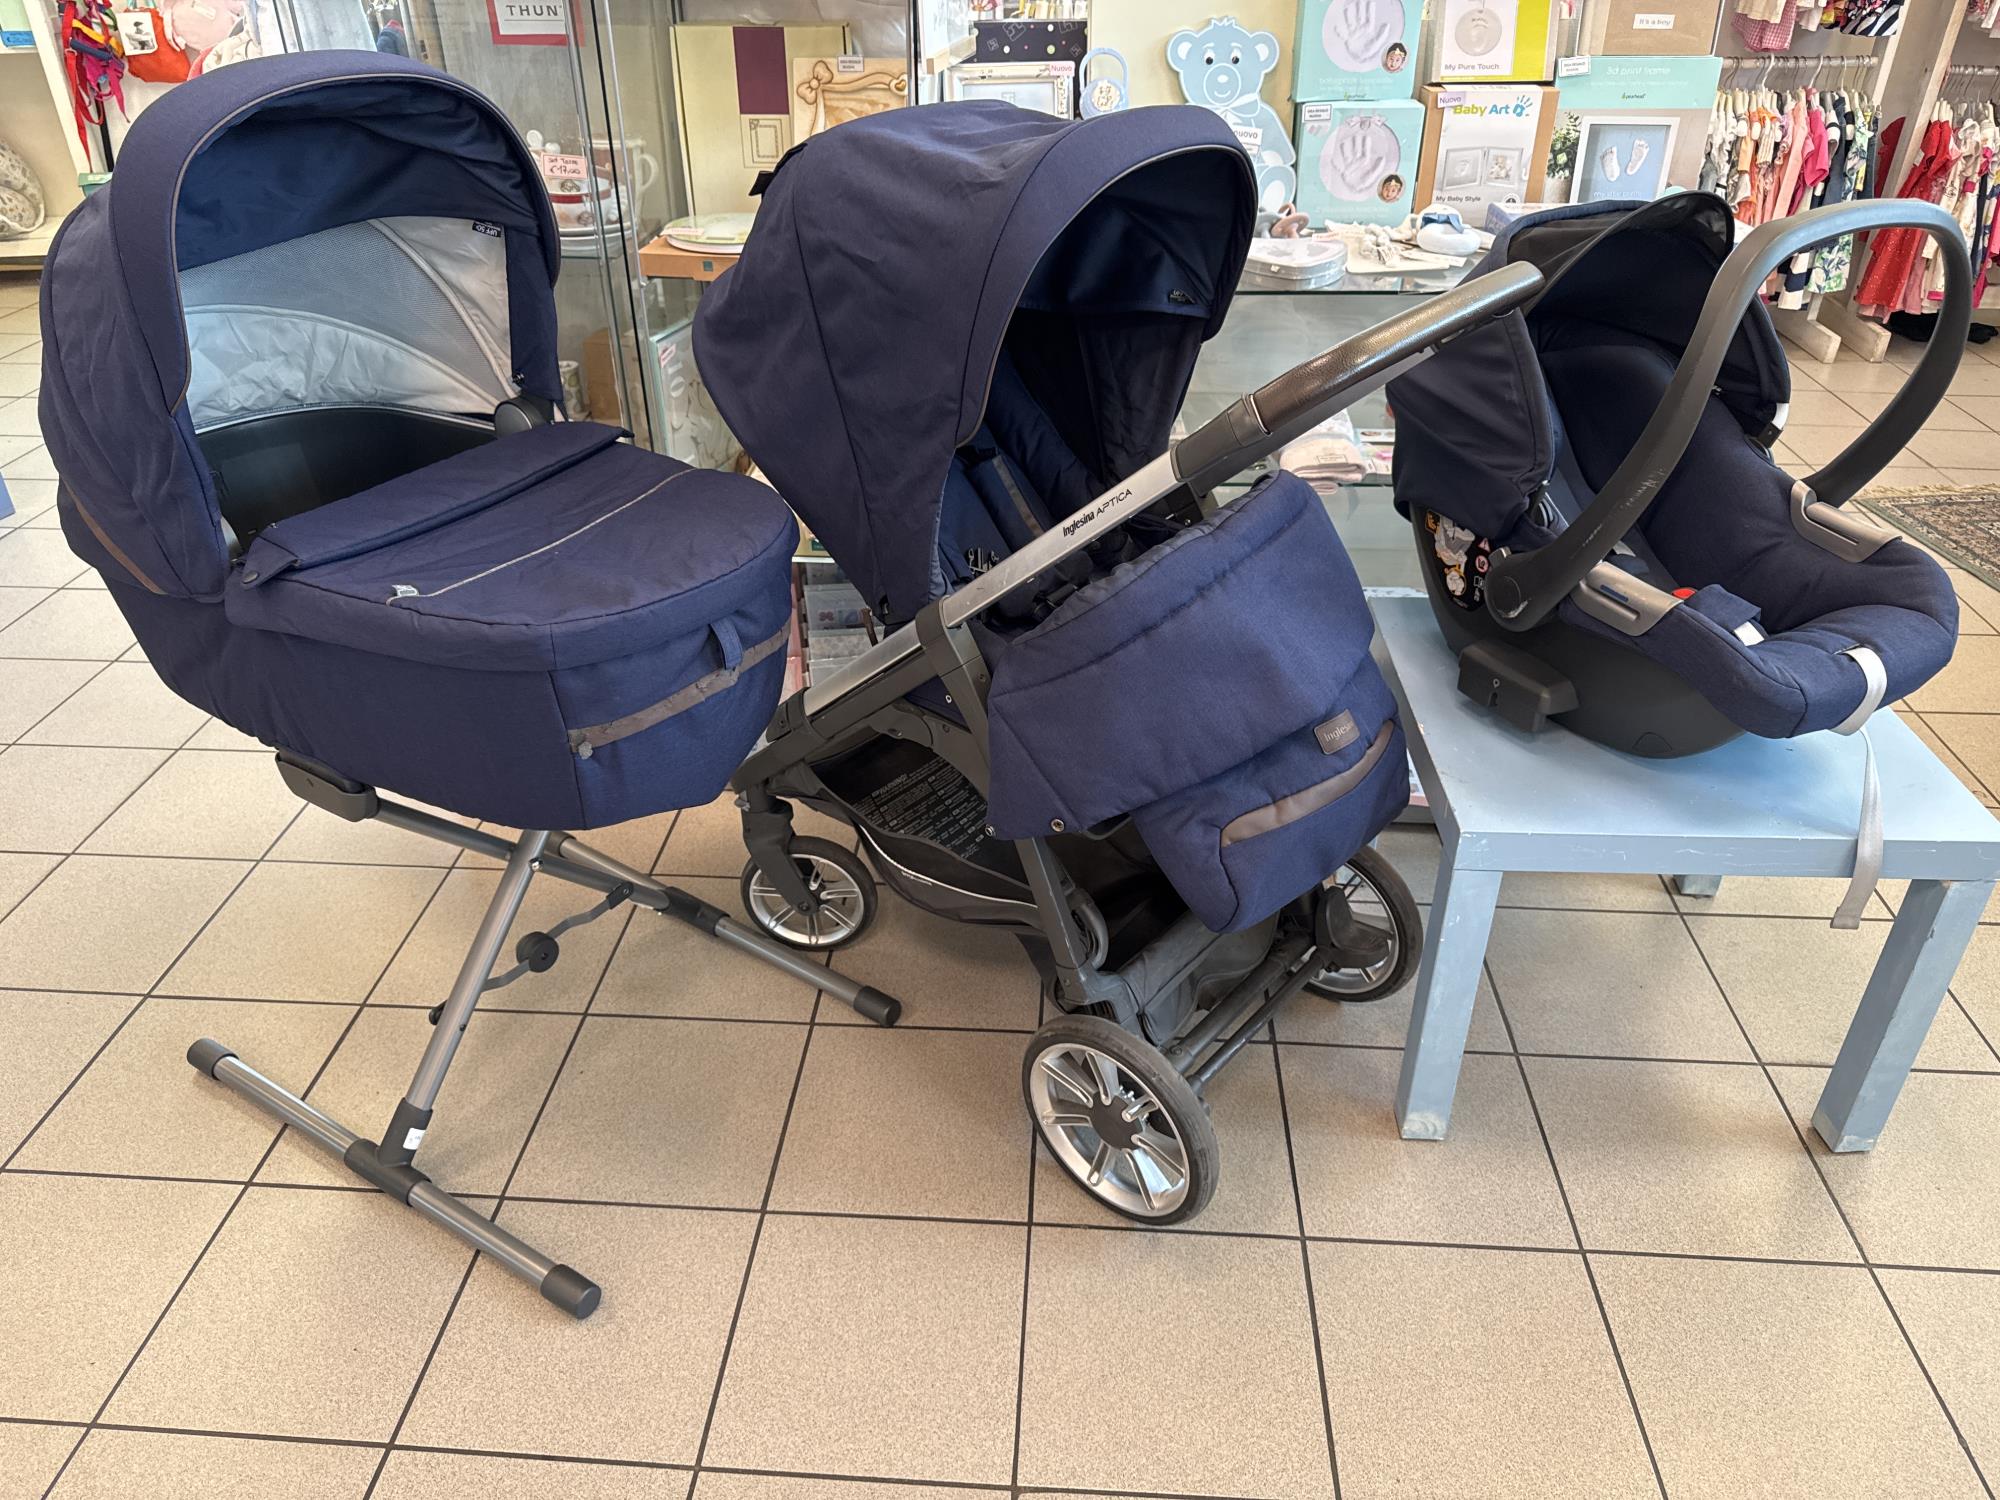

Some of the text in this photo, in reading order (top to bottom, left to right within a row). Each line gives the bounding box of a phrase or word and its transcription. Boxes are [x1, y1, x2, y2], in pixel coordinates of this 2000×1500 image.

[505, 5, 559, 16] THUN
[1444, 63, 1456, 71] My
[1439, 96, 1462, 104] Nuovo
[1453, 104, 1510, 116] Baby Art
[1063, 488, 1133, 537] Inglesina APTICA
